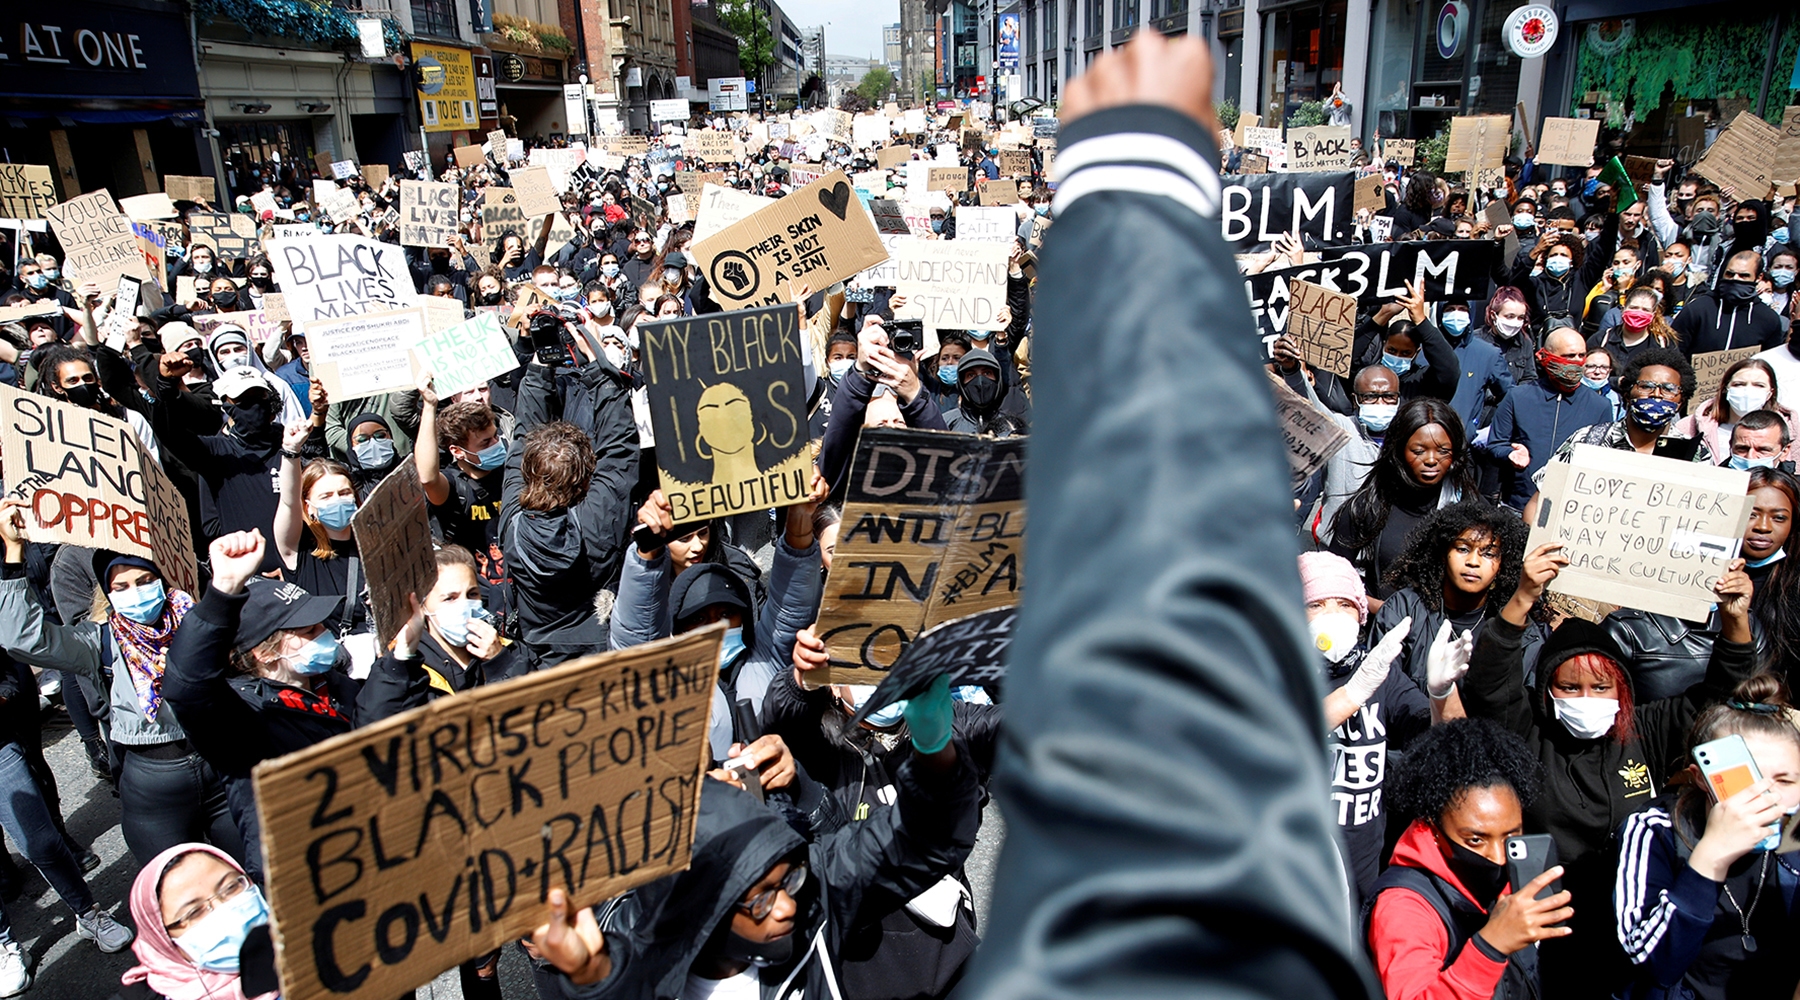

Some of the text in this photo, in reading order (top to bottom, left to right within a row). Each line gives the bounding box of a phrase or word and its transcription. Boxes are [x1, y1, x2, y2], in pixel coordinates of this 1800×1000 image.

[77, 28, 147, 69] ONE
[438, 101, 460, 119] TO LET
[1, 180, 55, 197] LIVES
[47, 193, 113, 227] YOUR
[1222, 184, 1343, 241] BLM.
[59, 215, 128, 247] SILENCE
[90, 241, 105, 250] IS
[746, 213, 822, 260] THEIR SKIN
[772, 234, 820, 266] IS NOT
[70, 240, 142, 270] VIOLENCE
[283, 244, 394, 285] BLACK
[775, 252, 830, 286] A SIN!
[898, 261, 1008, 286] UNDERSTAND
[316, 277, 395, 303] LIVES
[1290, 279, 1355, 327] BLACK
[911, 294, 992, 325] STAND
[322, 325, 351, 337] JUSTICE
[351, 324, 367, 332] FOR
[415, 313, 498, 357] THE UK
[644, 312, 800, 384] MY BLACK
[1287, 312, 1349, 350] LIVES
[432, 337, 489, 373] IS NOT
[434, 347, 514, 396] INNOCENT
[1693, 355, 1717, 371] END
[1289, 411, 1322, 435] POLICE
[668, 469, 811, 520] BEAUTIFUL
[1574, 471, 1729, 517] LOVE BLACK
[1563, 499, 1708, 535] PEOPLE THE
[1560, 525, 1721, 567] WAY YOU LOVE
[839, 560, 940, 603] IN
[942, 542, 1009, 606] #BLM
[1558, 546, 1718, 592] BLACK CULTURE
[305, 766, 354, 829] 2
[305, 707, 697, 904] BLACK PEOPLE
